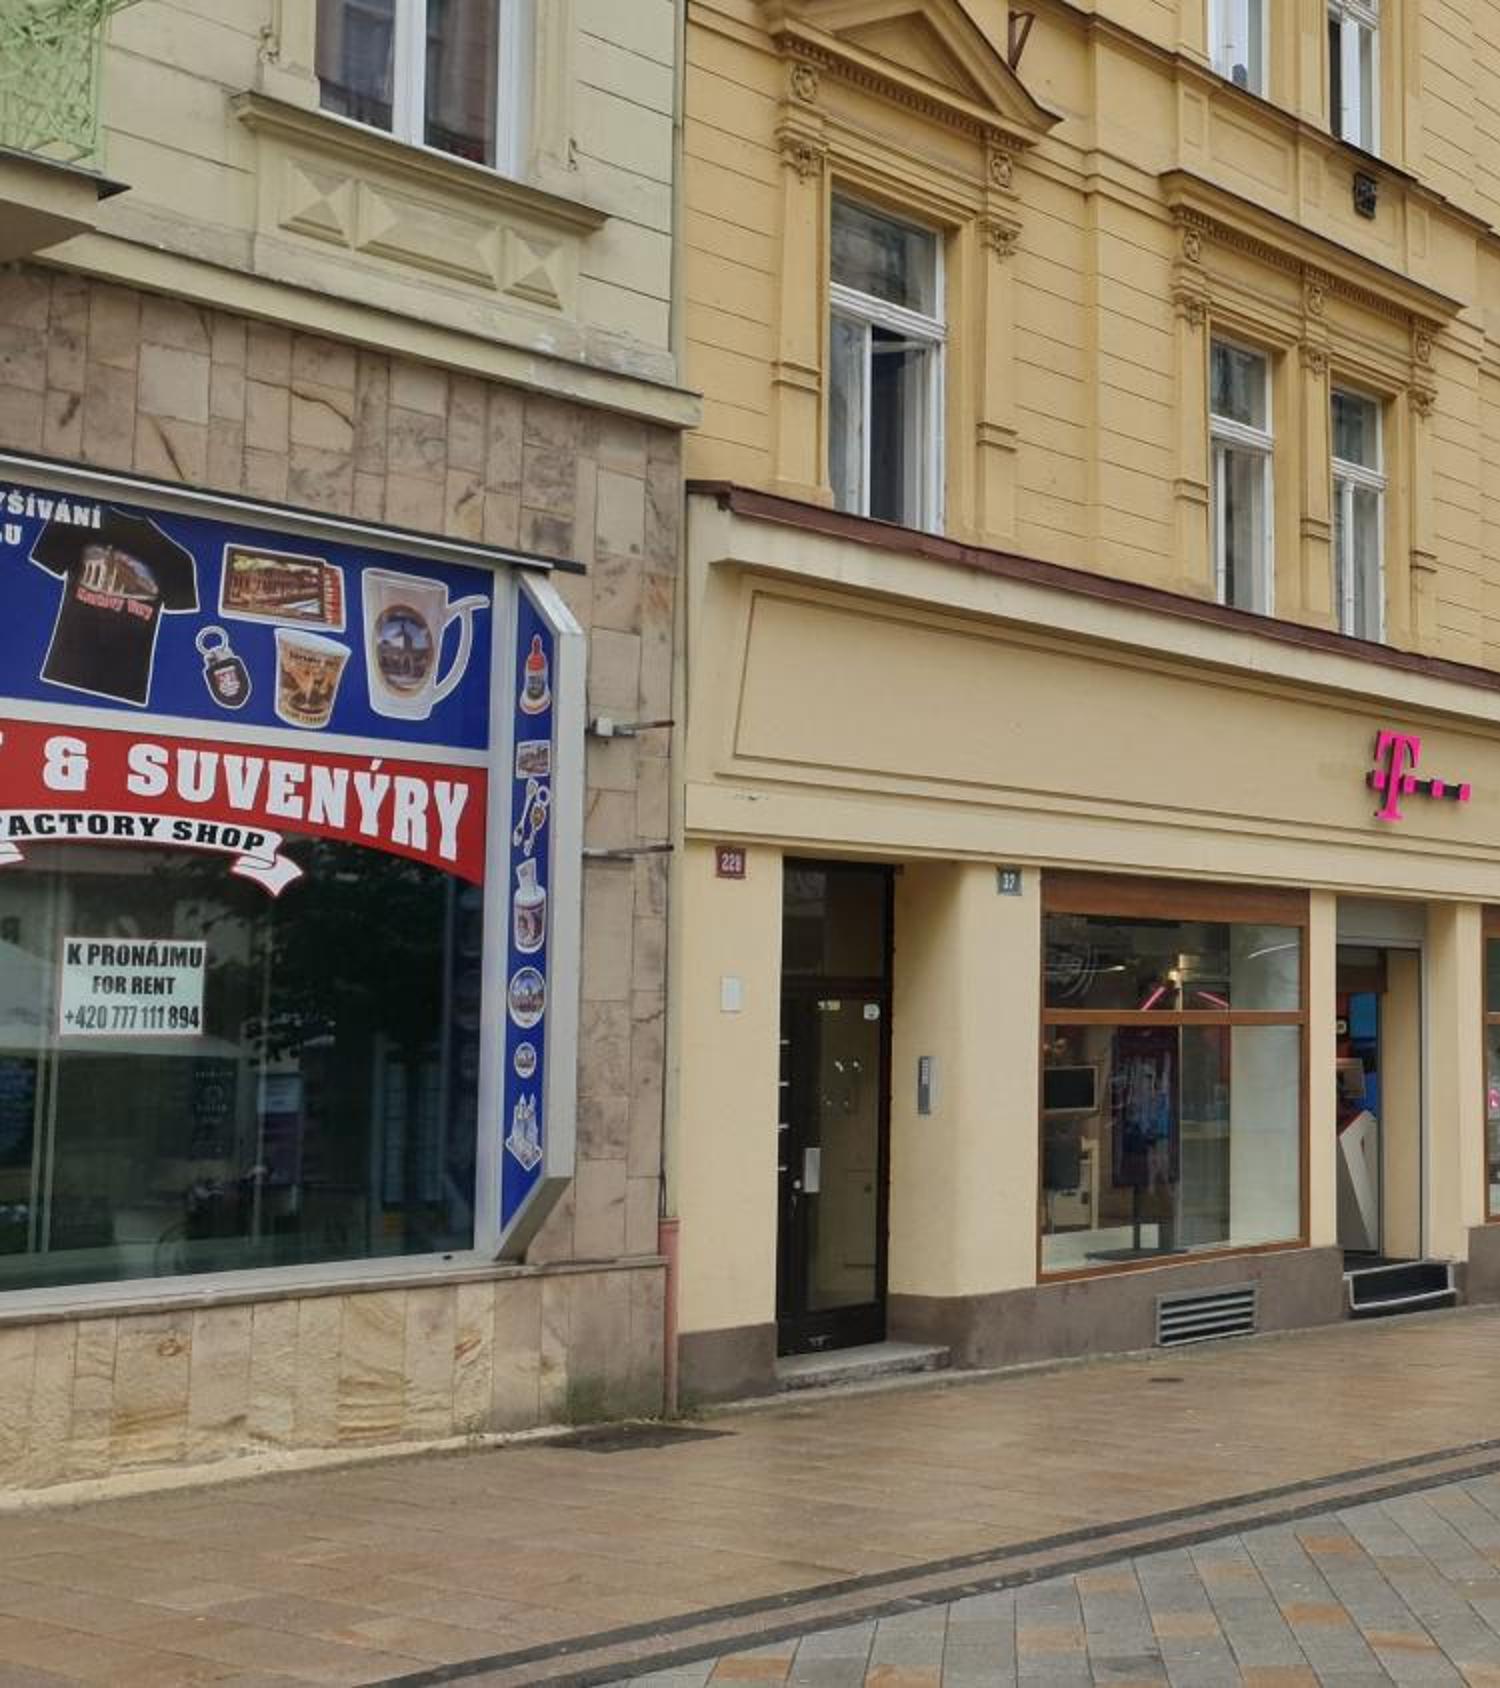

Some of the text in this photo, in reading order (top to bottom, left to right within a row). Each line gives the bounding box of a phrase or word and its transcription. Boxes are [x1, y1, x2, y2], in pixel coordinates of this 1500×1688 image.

[43, 735, 468, 862] & SUVENÝRY
[0, 813, 265, 851] ACTORY SHOP
[67, 942, 202, 968] K PRONÁJMU
[92, 975, 176, 995] FOR RENT
[64, 1005, 199, 1029] +420 777 111 894
